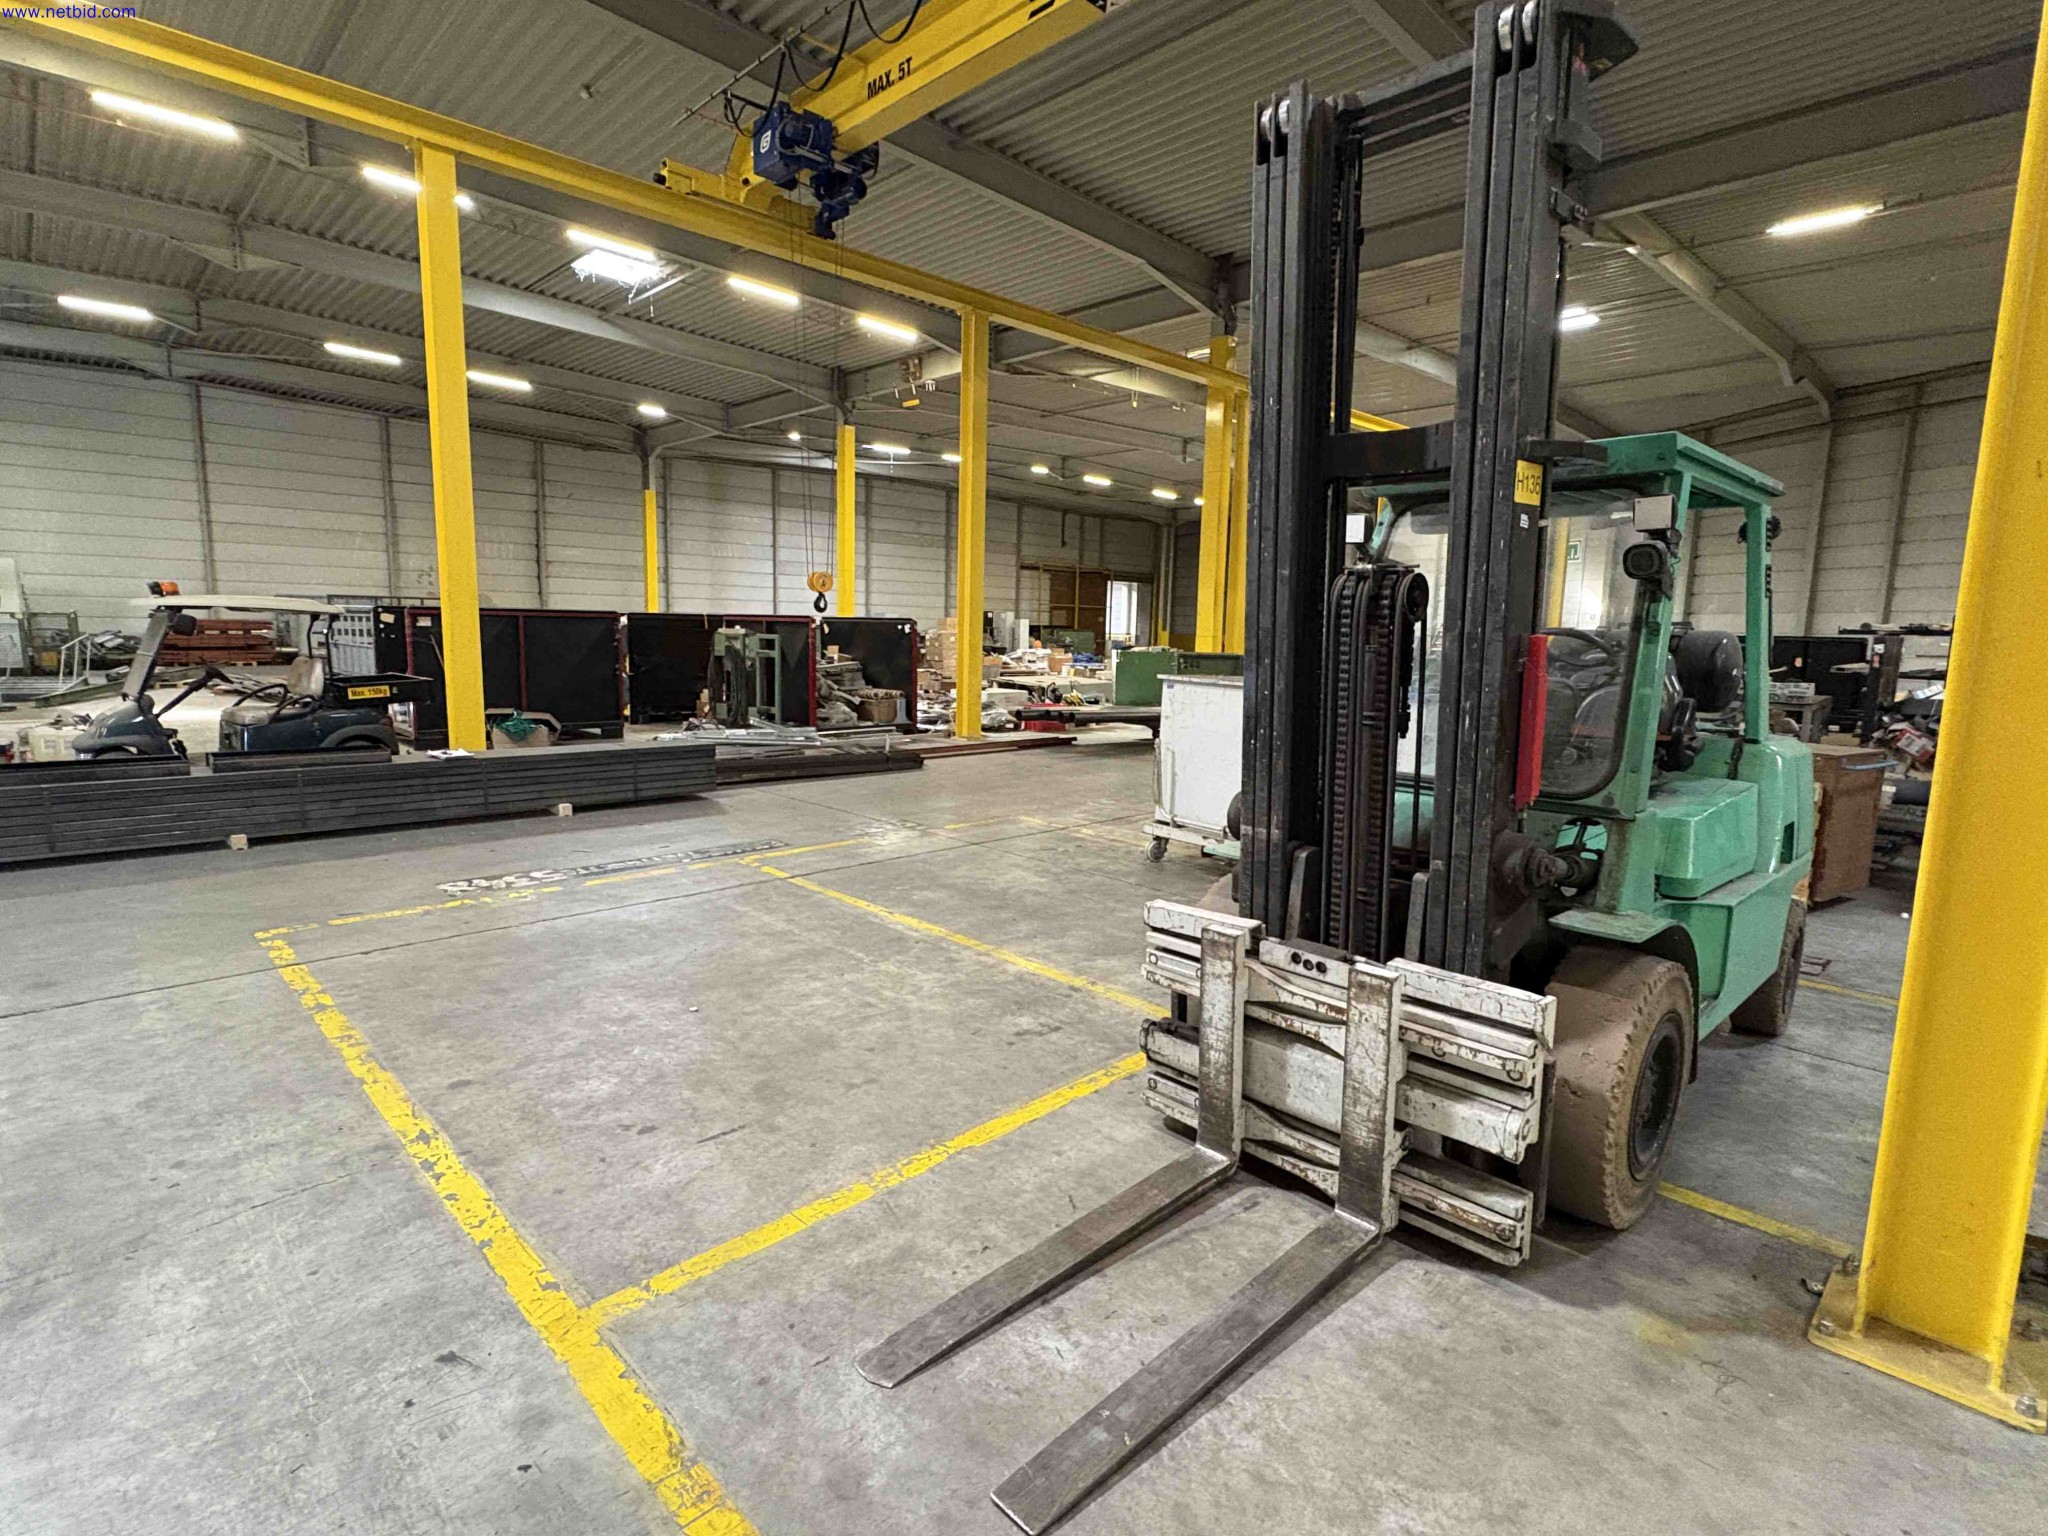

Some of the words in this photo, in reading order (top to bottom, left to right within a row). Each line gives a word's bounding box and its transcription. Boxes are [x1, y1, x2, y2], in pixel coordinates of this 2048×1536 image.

[867, 69, 895, 100] MAX.
[898, 56, 912, 80] 5T
[1516, 472, 1541, 495] H136
